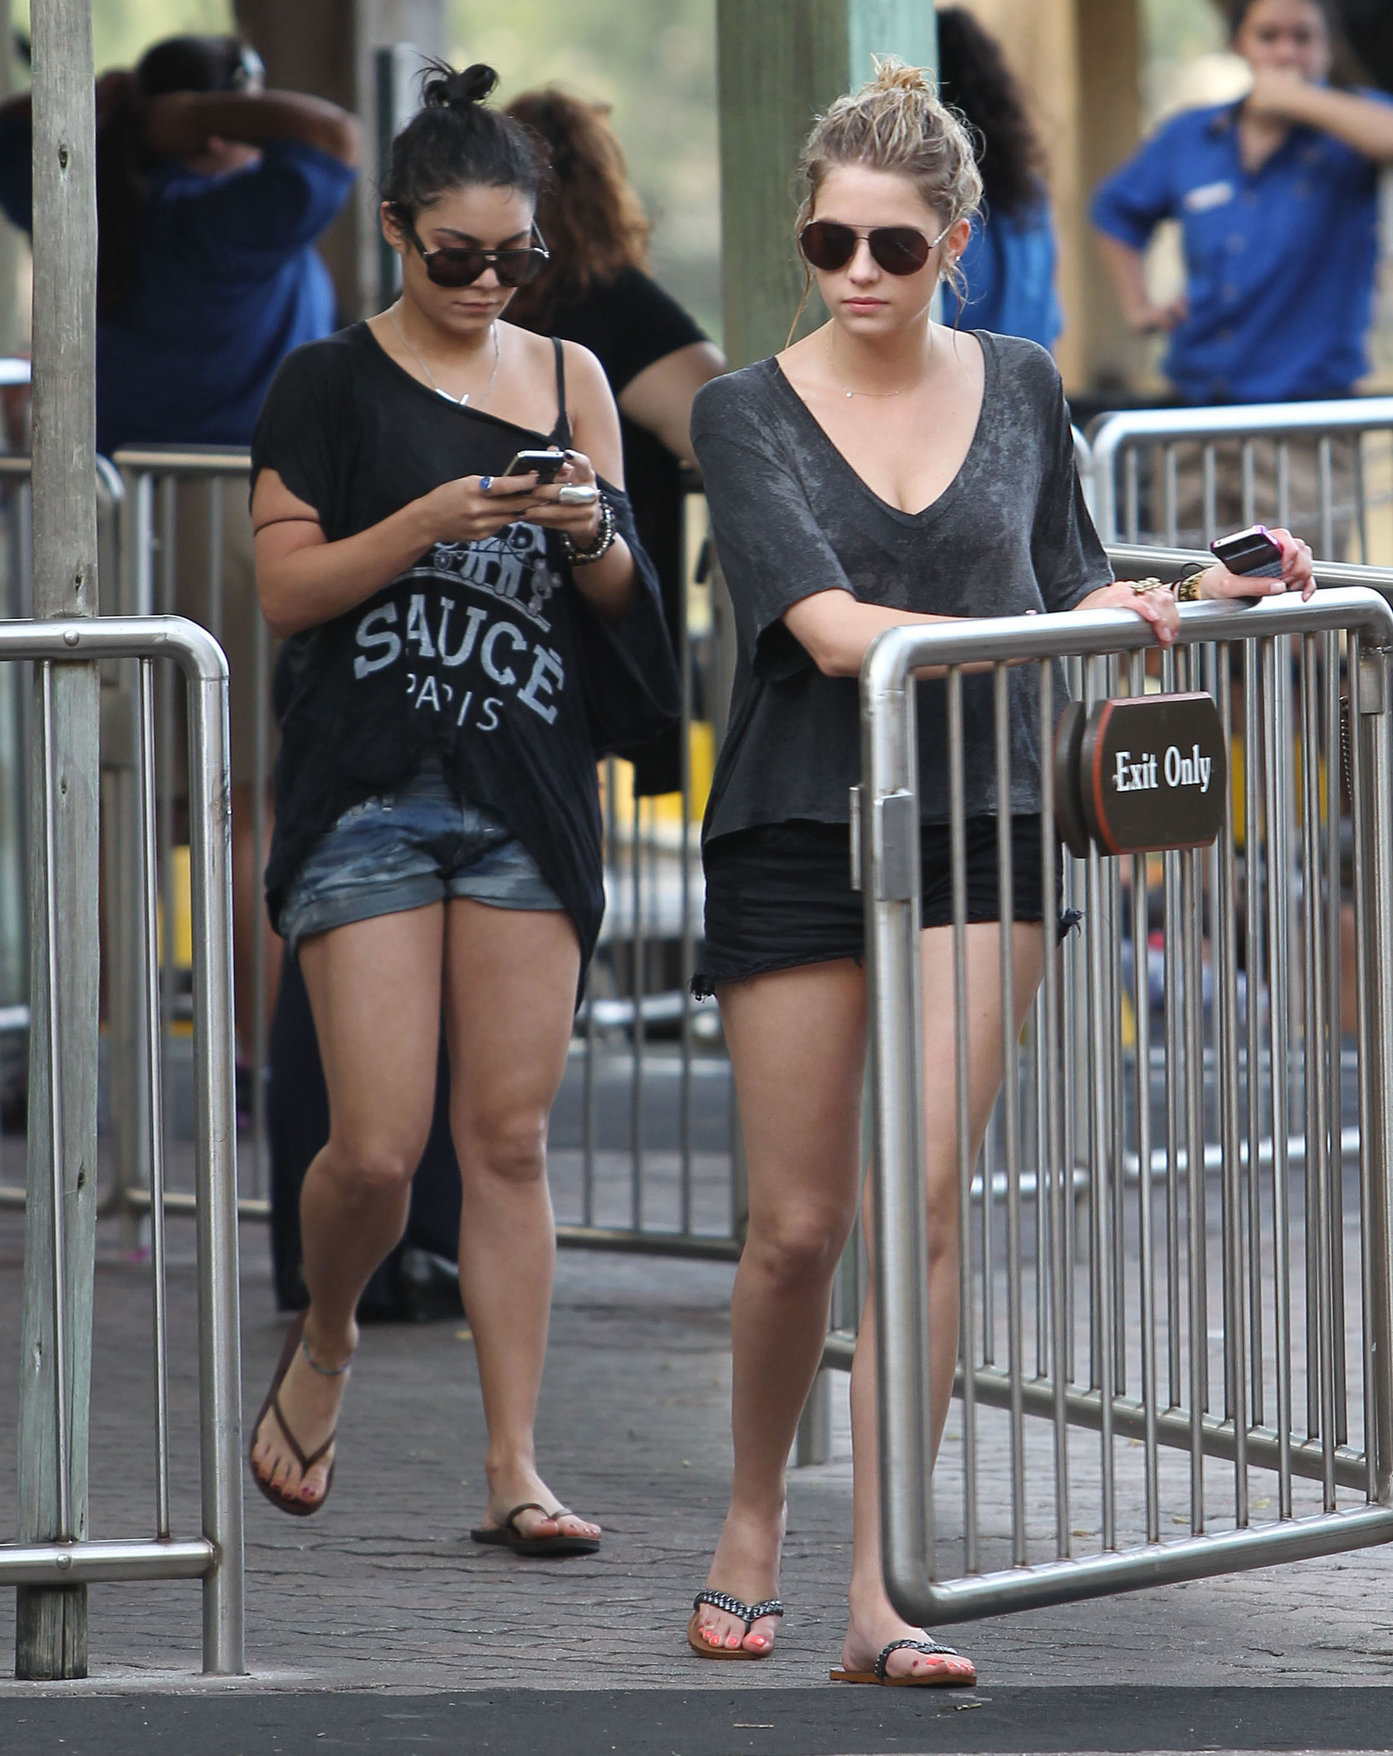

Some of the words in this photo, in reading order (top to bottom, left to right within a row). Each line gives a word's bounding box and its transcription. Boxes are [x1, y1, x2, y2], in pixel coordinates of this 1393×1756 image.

[353, 594, 564, 724] SAUCE
[405, 673, 504, 731] AIS
[1114, 751, 1159, 791] Exit
[1163, 744, 1212, 793] Only
